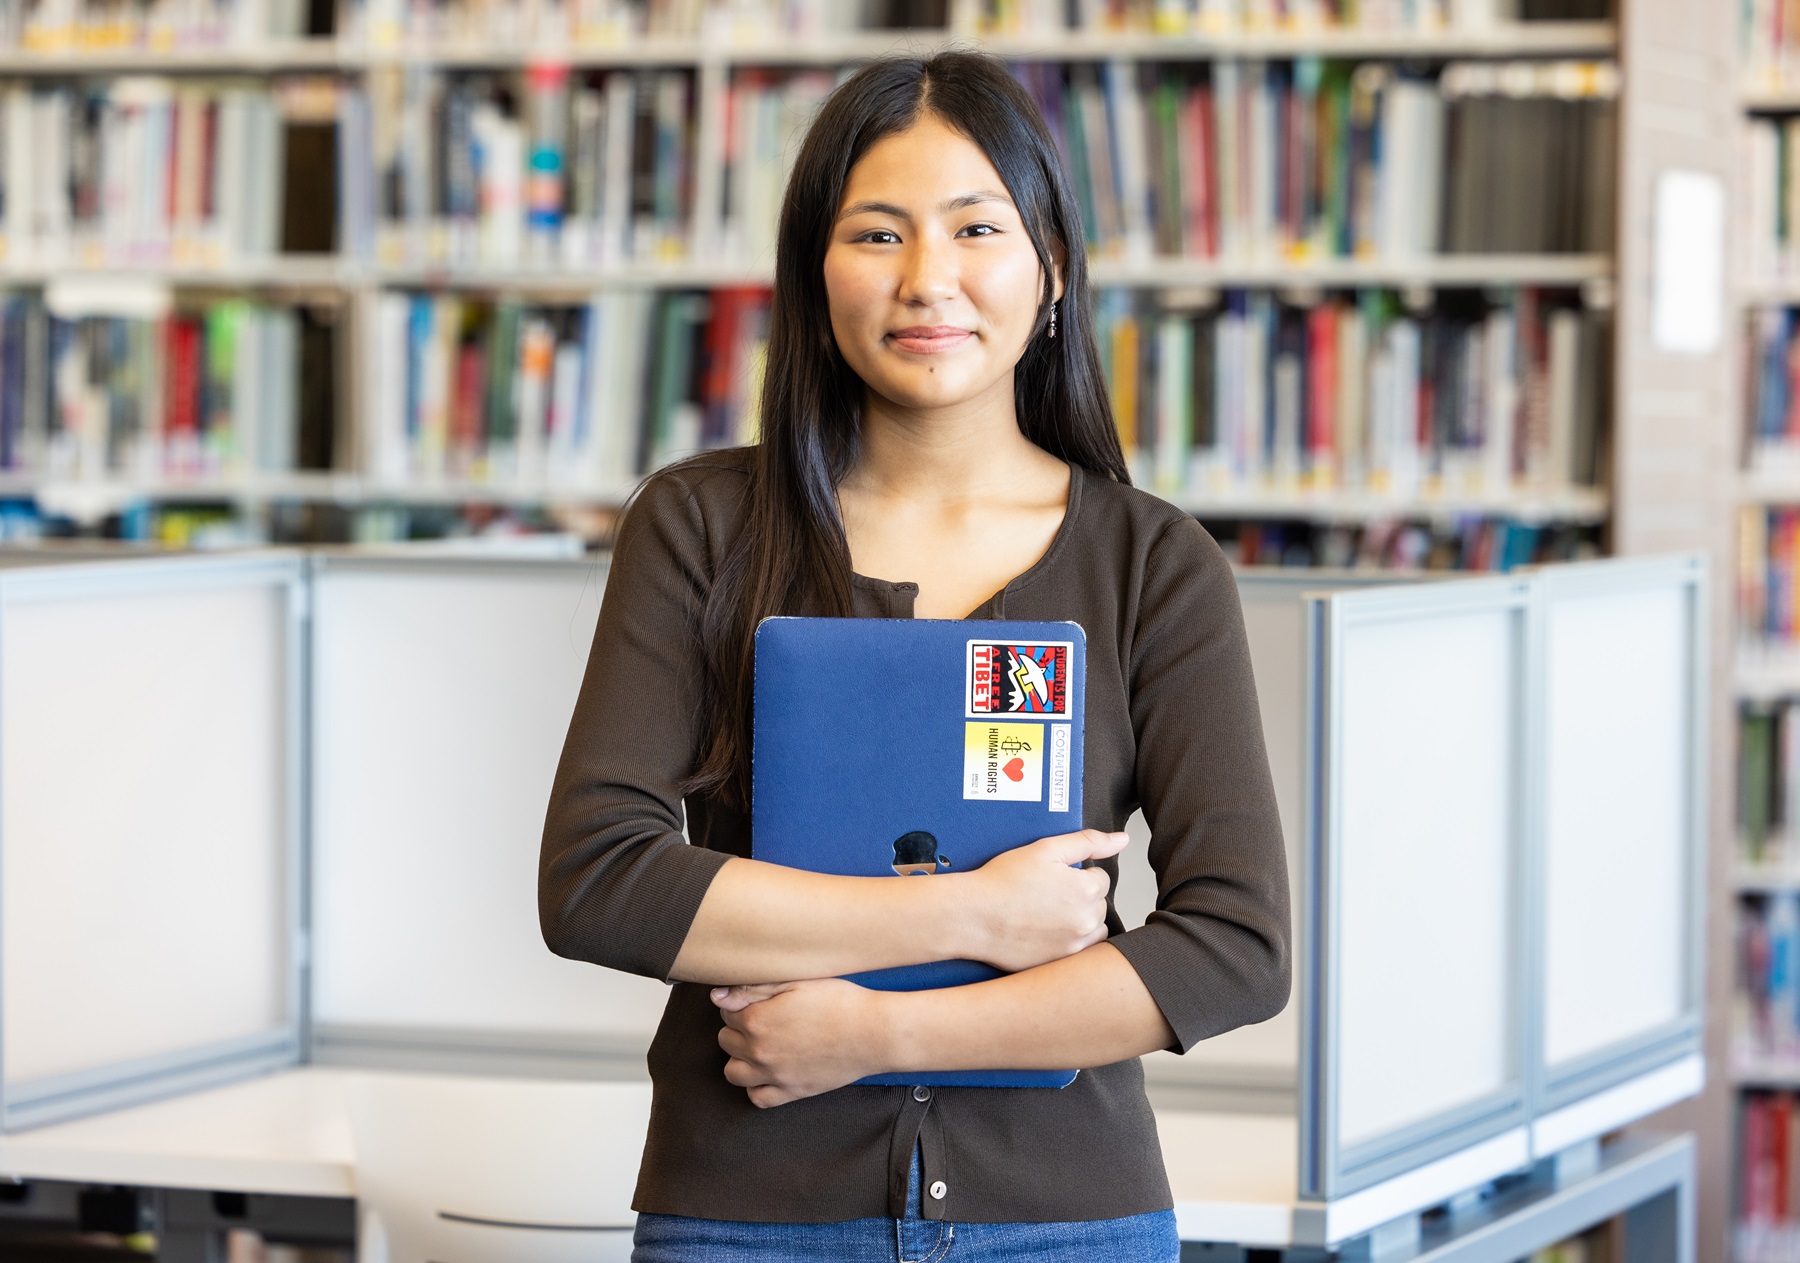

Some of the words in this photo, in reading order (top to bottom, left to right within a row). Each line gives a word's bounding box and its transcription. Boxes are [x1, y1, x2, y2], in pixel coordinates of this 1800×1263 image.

[992, 648, 1001, 656] A
[1054, 647, 1067, 692] STUDENTS
[975, 648, 991, 711] TIBET
[991, 663, 1001, 709] FREE
[1054, 695, 1065, 712] FOR
[988, 728, 998, 759] HUMAN
[987, 762, 998, 793] RIGHTS
[1054, 729, 1066, 806] COMMUNITY
